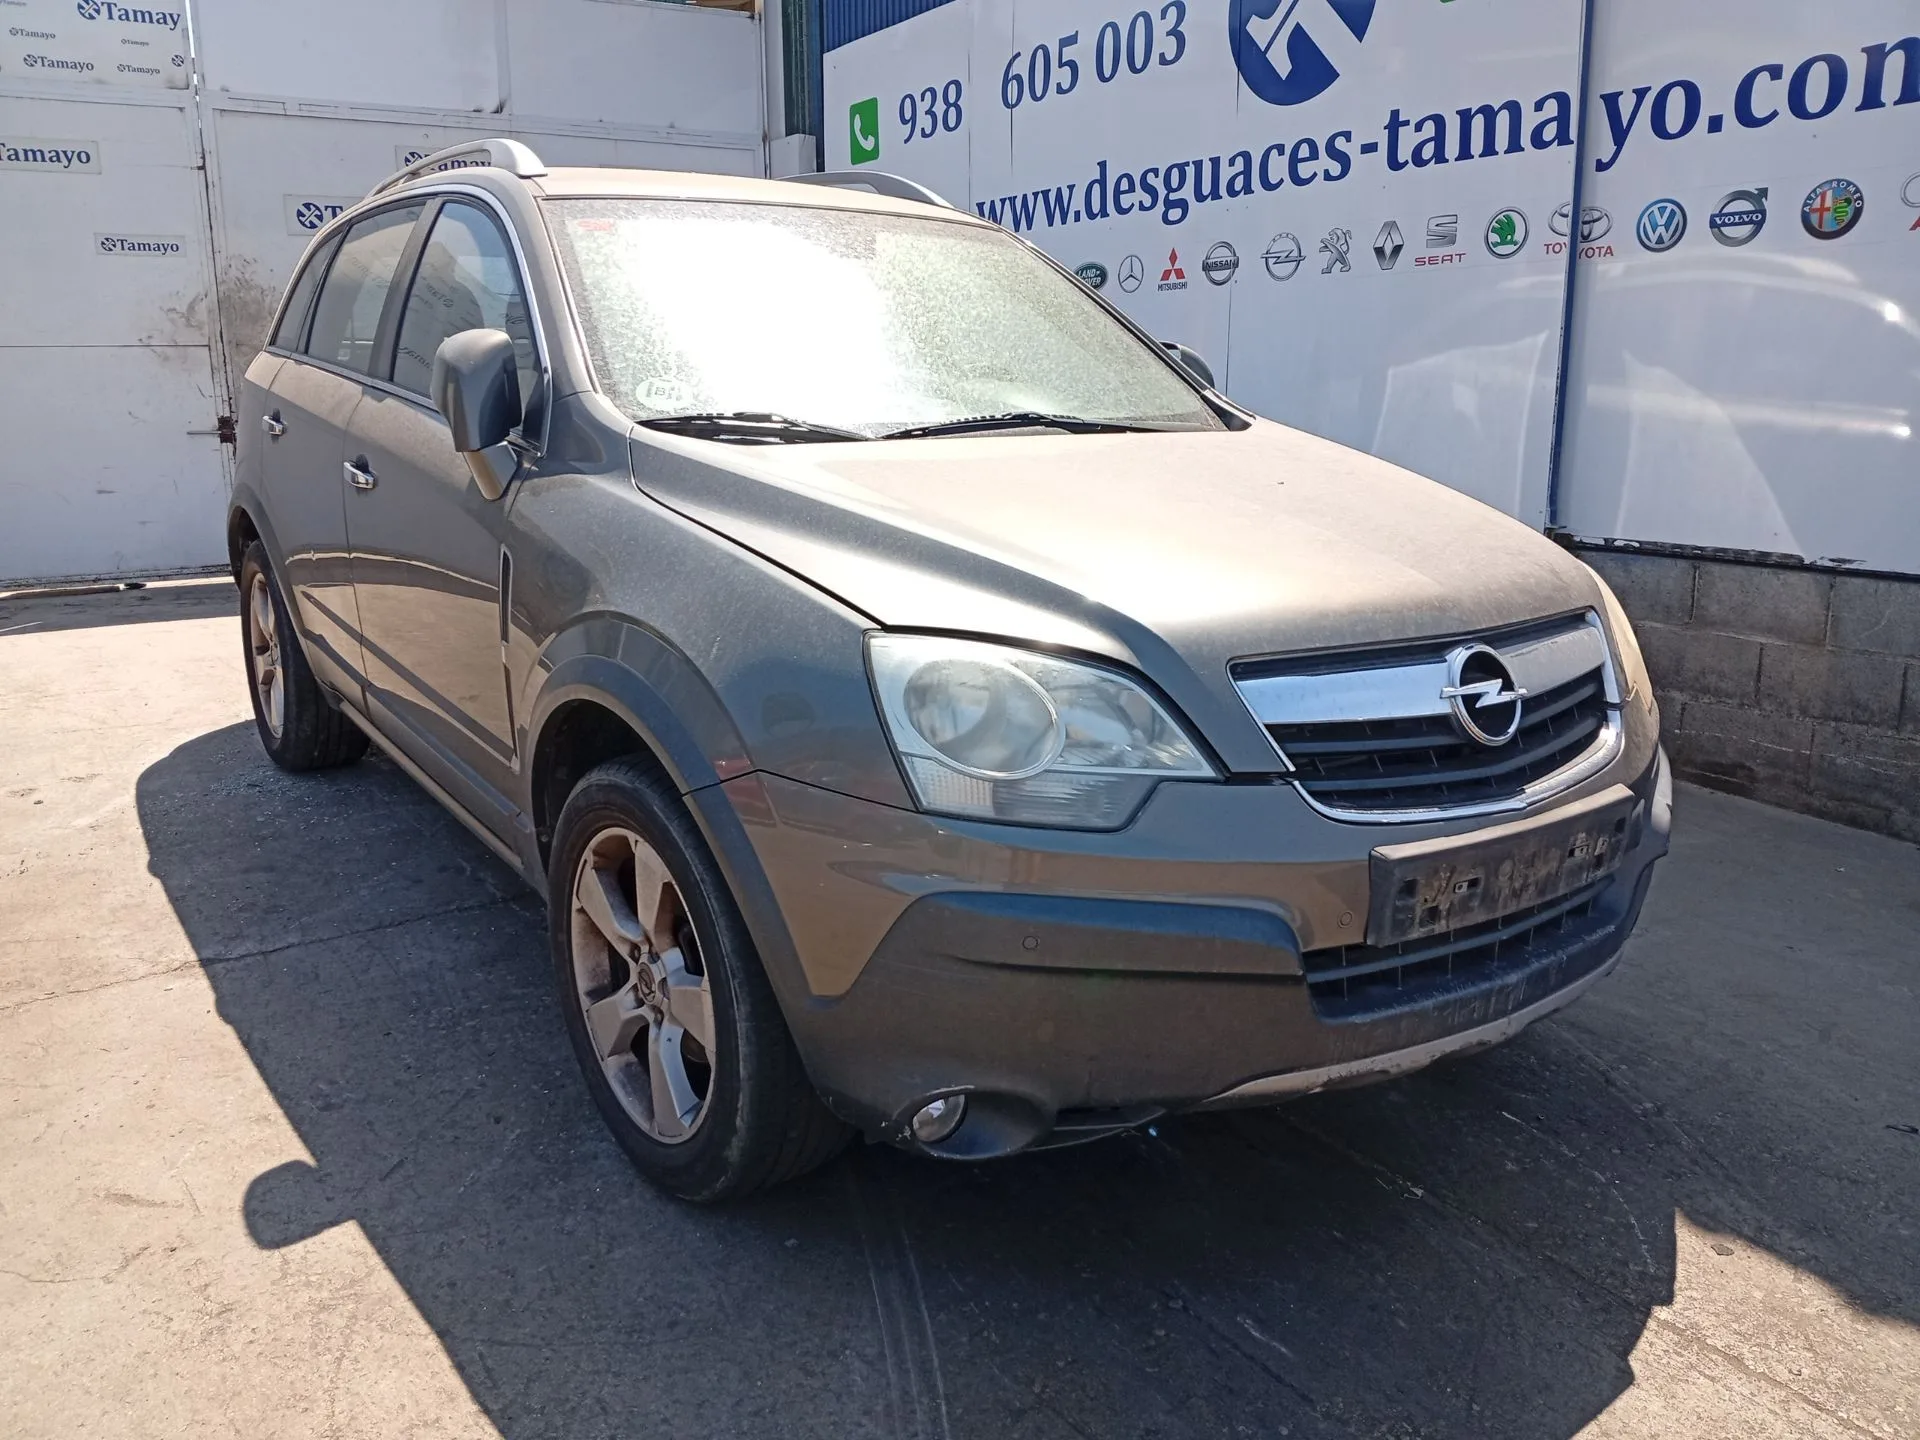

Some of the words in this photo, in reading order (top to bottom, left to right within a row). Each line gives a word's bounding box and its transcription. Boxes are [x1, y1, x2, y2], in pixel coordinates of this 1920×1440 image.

[19, 28, 56, 40] Tamayo
[37, 55, 95, 73] Tamayo
[125, 64, 161, 76] Tamayo
[898, 79, 964, 145] 938
[1001, 30, 1080, 110] 605
[1095, 0, 1187, 84] 003
[1831, 180, 1863, 208] ROMEO
[1713, 212, 1764, 226] VOLVO
[116, 238, 180, 256] Tamayo
[1205, 258, 1236, 270] NISSAN
[1414, 252, 1467, 267] SEAT
[1157, 281, 1188, 292] MITSUBISHI
